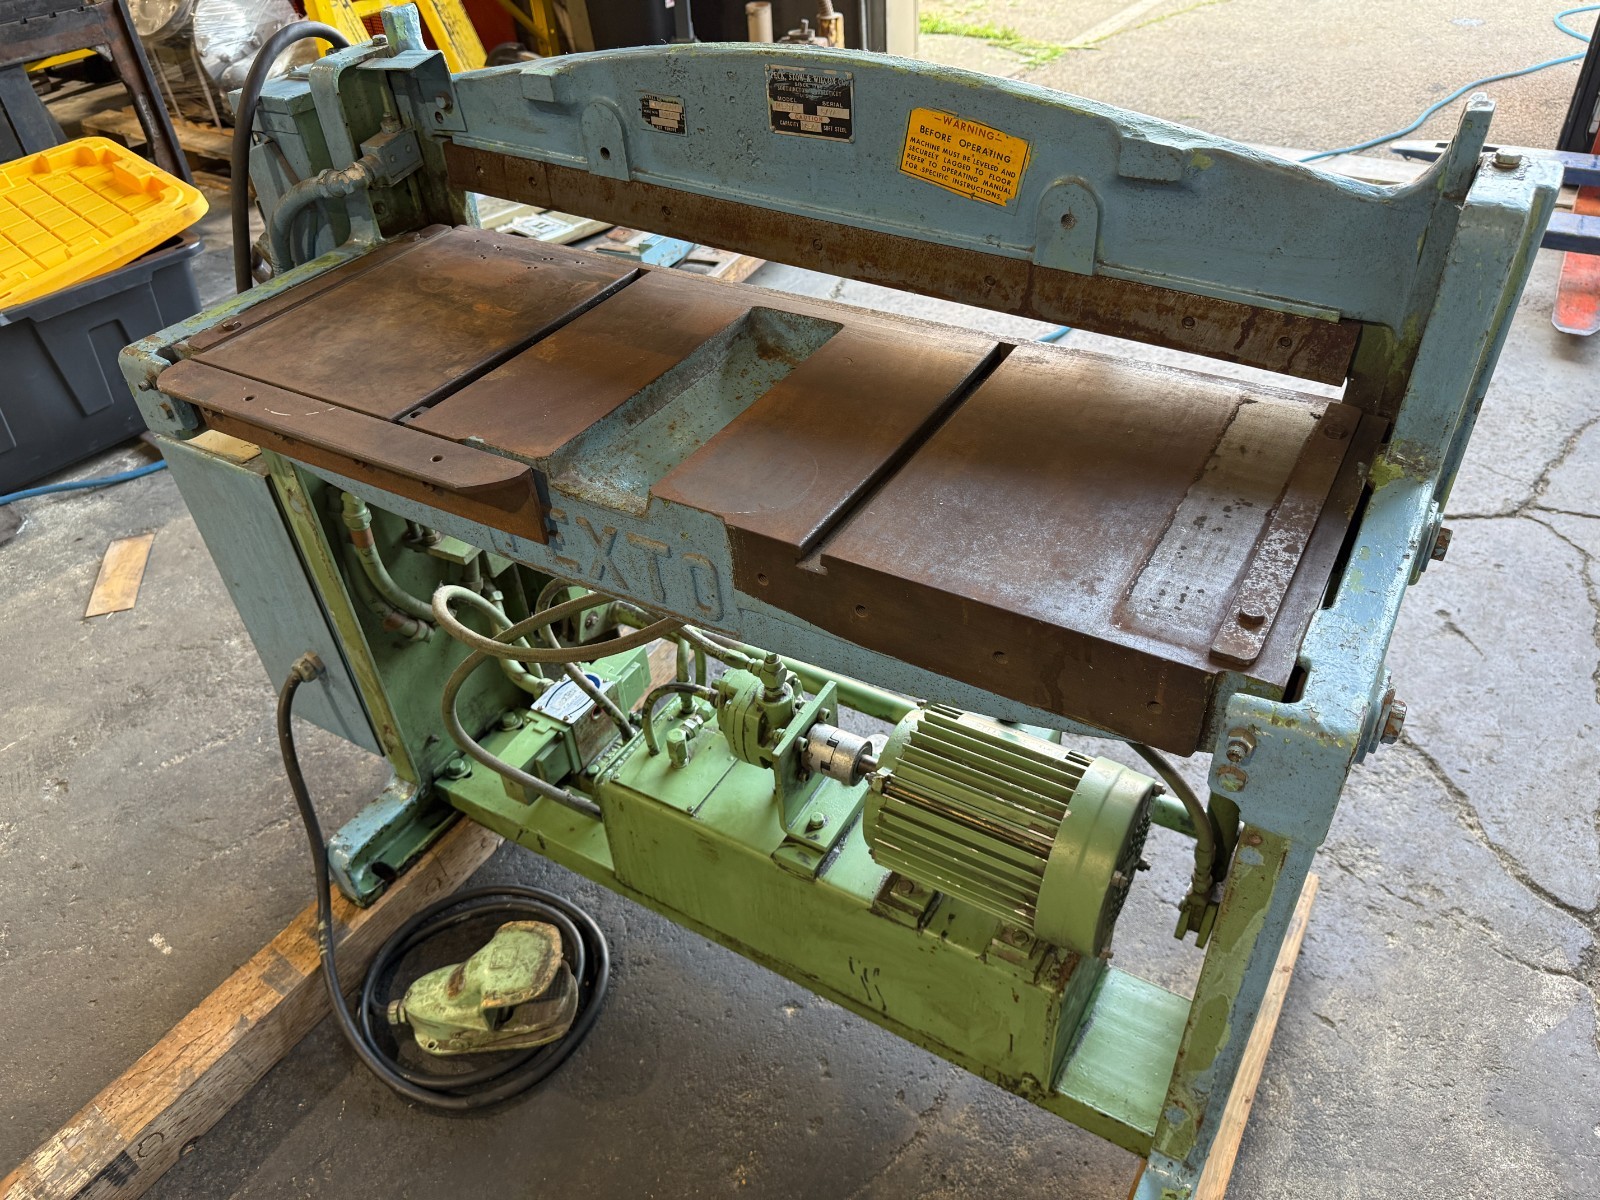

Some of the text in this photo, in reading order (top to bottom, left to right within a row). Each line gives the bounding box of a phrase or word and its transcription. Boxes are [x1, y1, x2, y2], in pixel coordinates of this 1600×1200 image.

[779, 119, 800, 128] CAPACITY
[908, 144, 940, 161] SECURELY
[943, 153, 971, 172] LAGGED
[974, 167, 984, 176] TO
[909, 136, 1016, 179] MACHINE MUST BE LEVELED AND
[919, 124, 1012, 164] BEFORE OPERATING
[904, 160, 918, 171] FOR
[921, 167, 949, 182] SPECIFIC
[906, 152, 1012, 195] REFER TO OPERATING MANUAL
